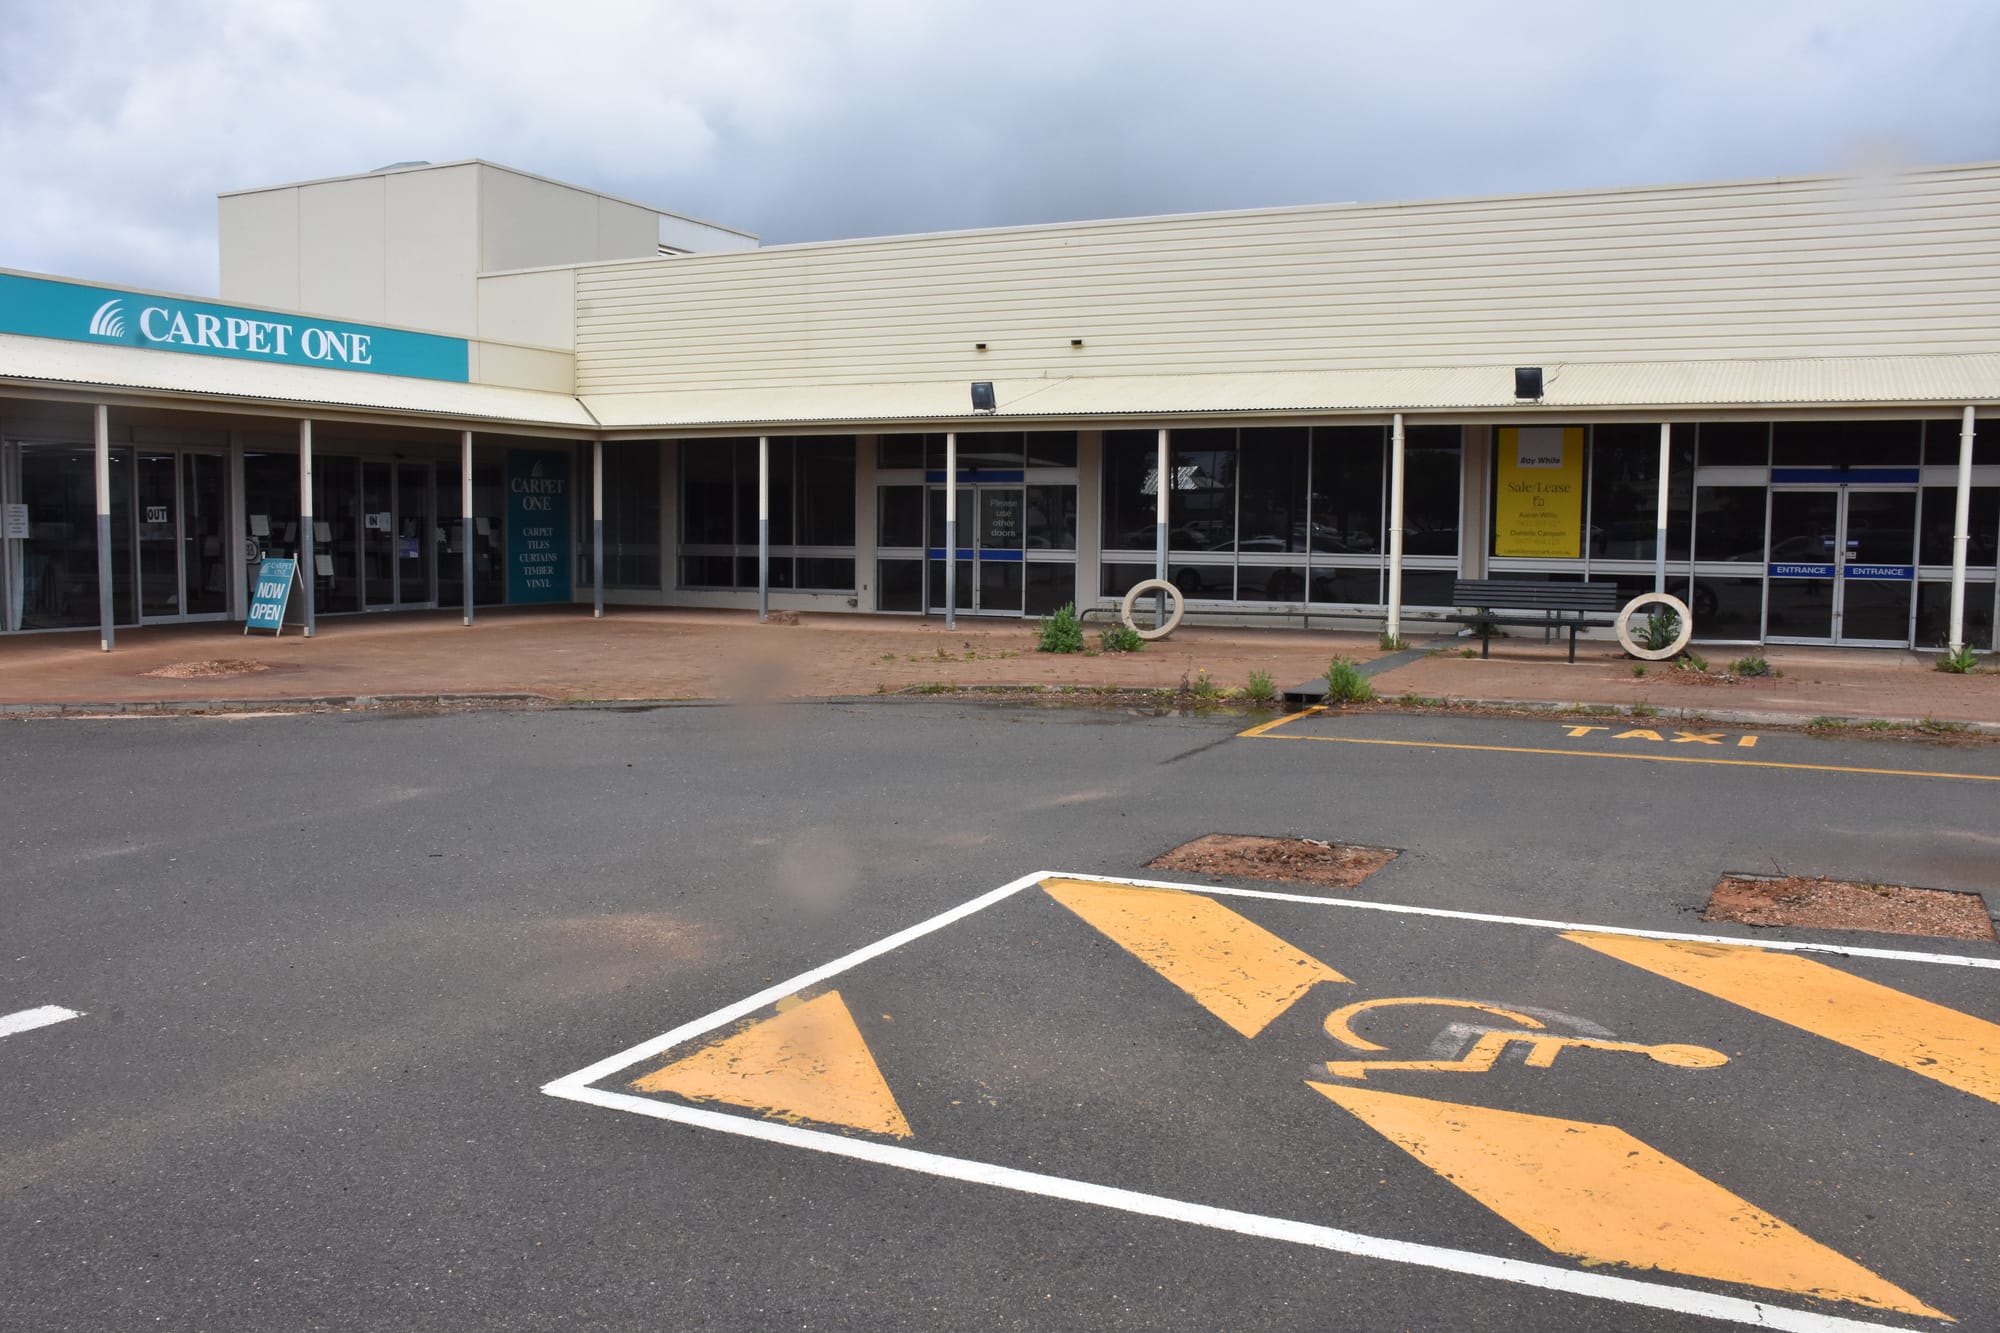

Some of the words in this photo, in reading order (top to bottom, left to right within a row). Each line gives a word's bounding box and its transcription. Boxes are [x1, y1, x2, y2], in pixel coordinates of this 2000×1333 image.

[139, 307, 292, 355] CARPET
[301, 328, 371, 365] ONE
[1520, 456, 1536, 465] Ray
[1538, 456, 1561, 464] White
[511, 477, 565, 494] CARPET
[522, 496, 552, 511] ONE
[990, 498, 1017, 507] Please
[147, 507, 167, 521] OUT
[368, 515, 378, 526] IN
[992, 519, 1016, 527] other
[522, 527, 553, 537] CARPET
[991, 529, 1016, 537] doors
[527, 540, 550, 549] TILES
[519, 552, 558, 562] CURTAINS
[523, 566, 554, 575] TIMBER
[1777, 566, 1826, 575] ENTRANCE
[1852, 567, 1904, 576] ENTRANCE
[526, 578, 552, 588] VINYL
[257, 582, 285, 599] NOW
[251, 603, 281, 620] OPEN
[1562, 725, 1758, 747] TAXI
